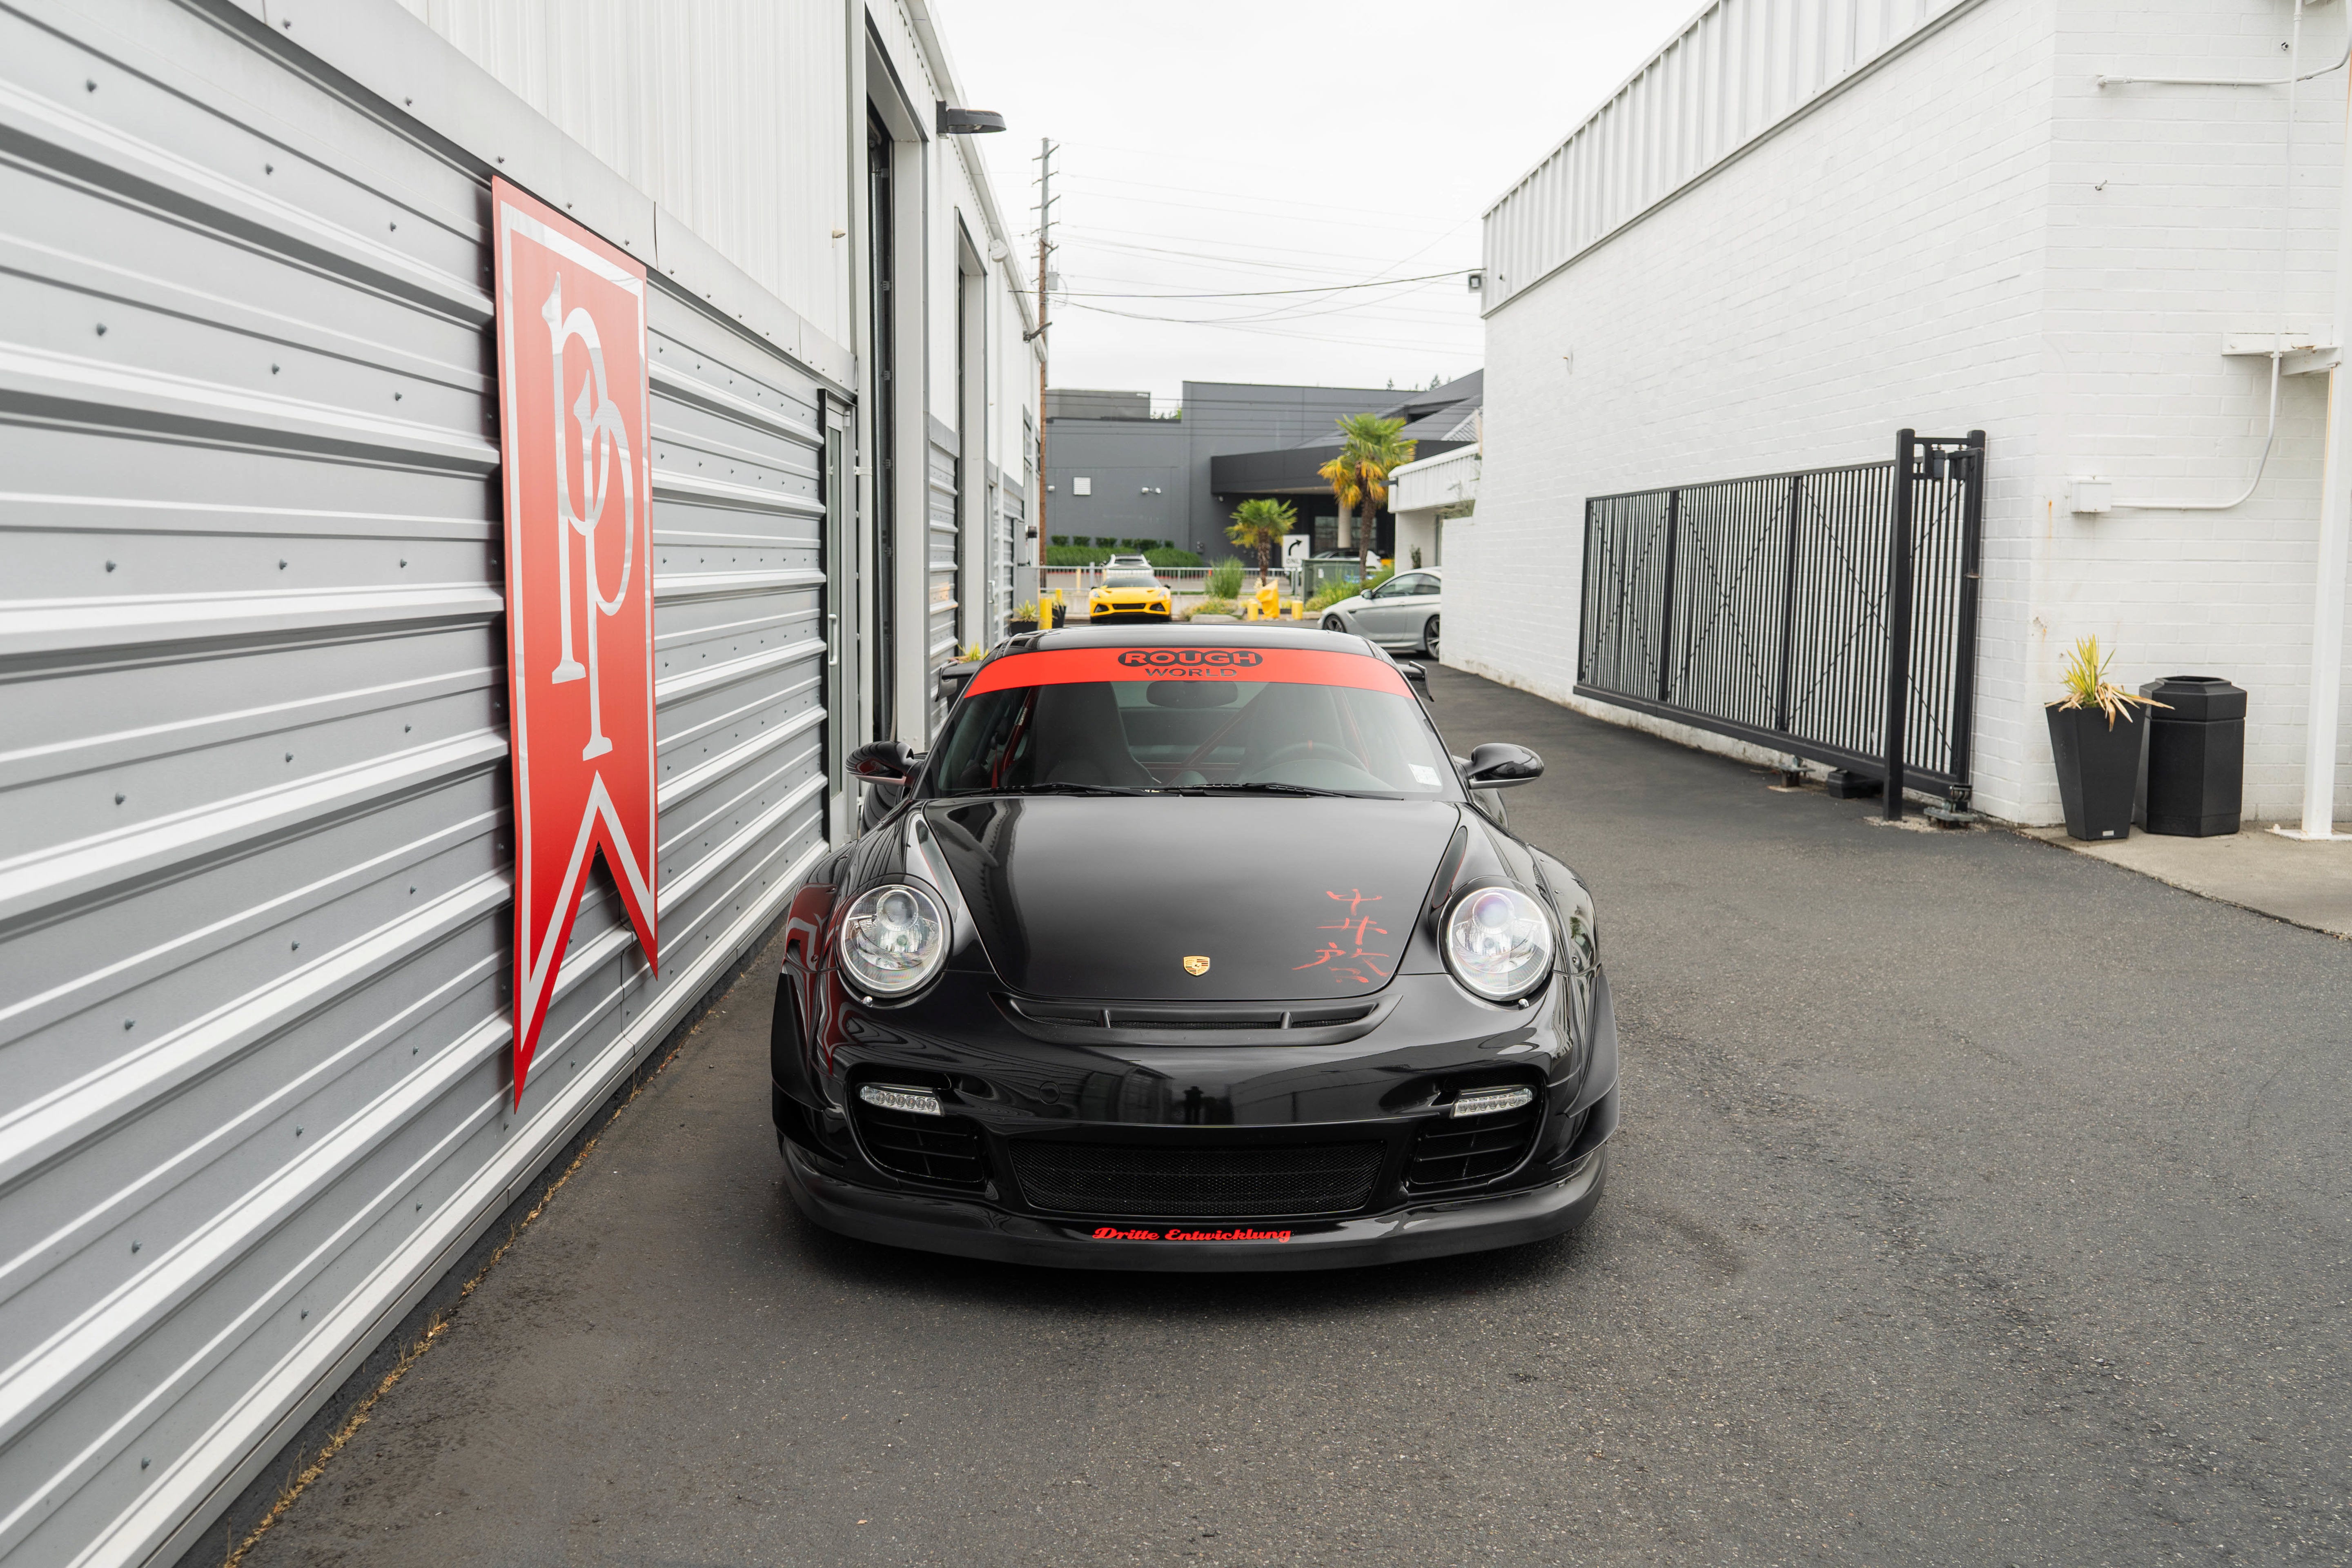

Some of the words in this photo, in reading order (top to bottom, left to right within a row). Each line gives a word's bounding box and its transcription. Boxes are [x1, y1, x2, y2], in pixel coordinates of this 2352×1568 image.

[1125, 653, 1256, 664] ROUGH
[1145, 668, 1237, 677] WORLD
[1092, 1227, 1159, 1240] Dritte
[1165, 1229, 1291, 1243] Entwicklung
